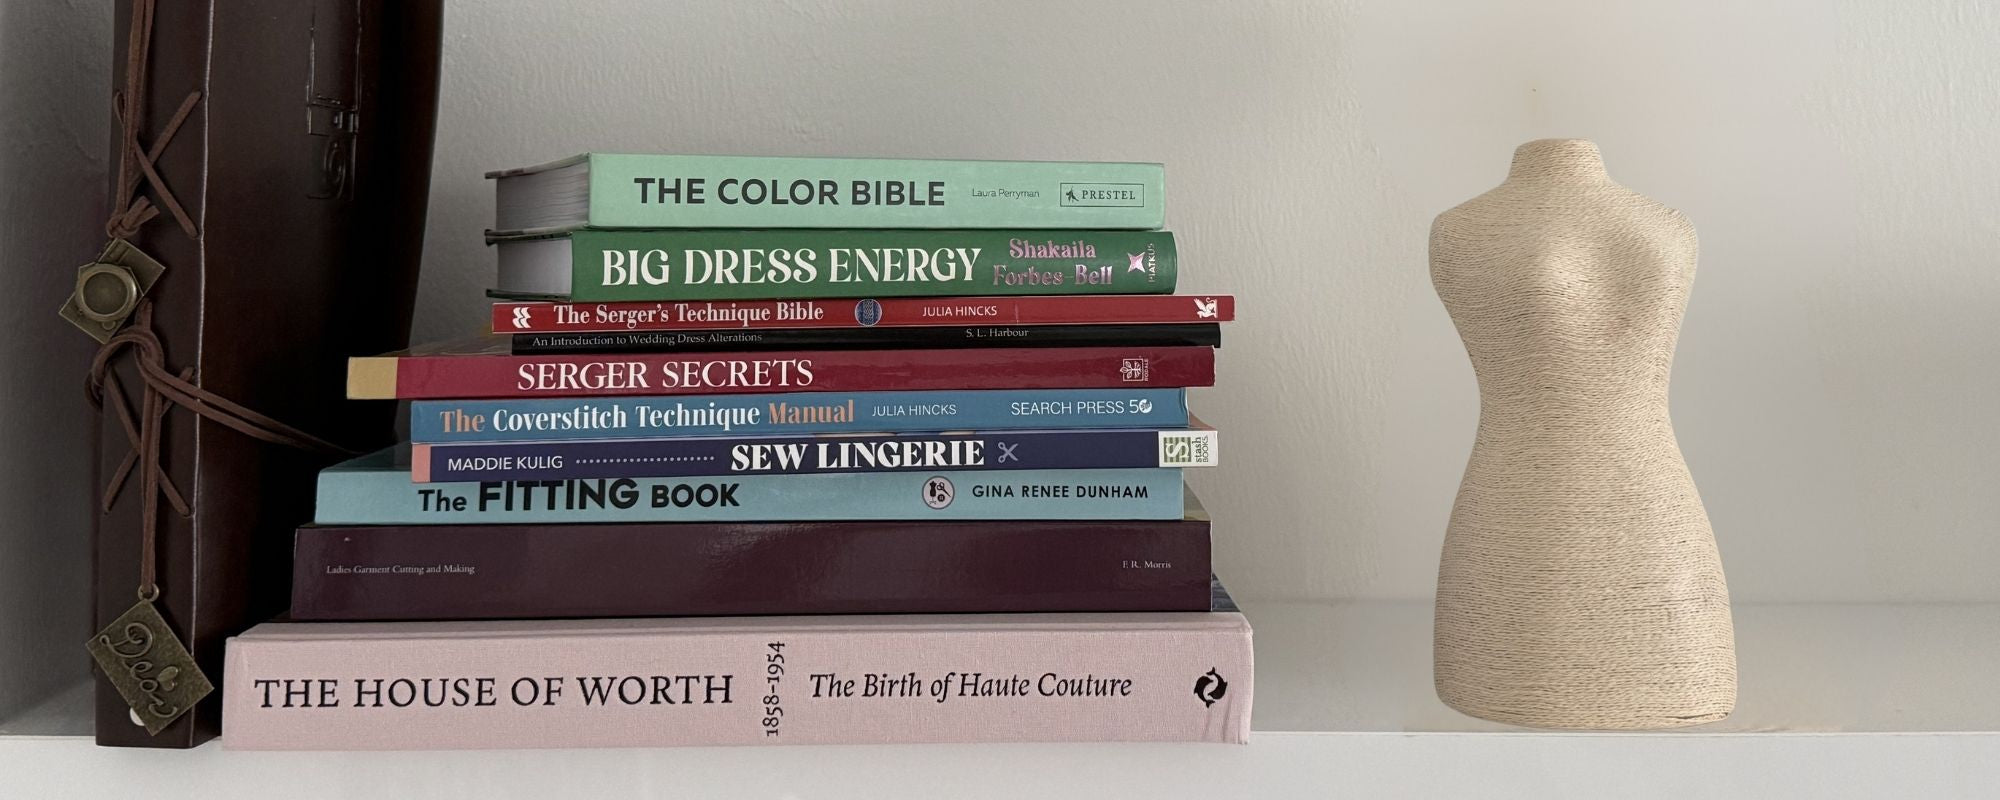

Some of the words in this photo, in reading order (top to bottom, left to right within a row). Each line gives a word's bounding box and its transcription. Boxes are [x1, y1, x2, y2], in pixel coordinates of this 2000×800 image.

[634, 177, 705, 204] THE
[717, 177, 839, 206] COLOR
[852, 180, 945, 206] BIBLE
[972, 188, 996, 198] Laura
[998, 188, 1040, 199] Perryman
[1082, 190, 1136, 200] PRESTEL
[1009, 238, 1097, 259] Shakaila
[602, 249, 670, 286] BIG
[684, 248, 817, 285] DRESS
[829, 247, 981, 283] ENERGY
[554, 305, 590, 324] The
[595, 303, 669, 329] Serger's
[675, 303, 771, 330] Technique
[776, 301, 824, 321] Bible
[922, 305, 953, 317] JULIA
[955, 305, 997, 316] HINCKS
[532, 337, 548, 347] An
[551, 335, 613, 346] Introduction
[616, 337, 626, 345] to
[629, 334, 675, 346] Wedding
[678, 335, 705, 344] Dress
[708, 332, 762, 343] Alterations
[966, 328, 974, 338] S.
[976, 328, 986, 338] L.
[989, 327, 1029, 338] Harbour
[517, 362, 650, 390] SERGER
[662, 359, 813, 387] SECRETS
[440, 410, 485, 433] The
[493, 405, 626, 432] Coverstitch
[635, 402, 760, 430] Technique
[769, 400, 854, 423] Manual
[872, 404, 907, 417] JULIA
[909, 403, 957, 416] HINCKS
[1011, 401, 1072, 416] SEARCH
[1077, 400, 1124, 414] PRESS
[731, 443, 808, 471] SEW
[817, 440, 984, 469] LINGERIE
[1192, 437, 1201, 462] stash
[448, 458, 513, 471] MADDIE
[516, 456, 563, 470] KULIG
[418, 490, 467, 512] The
[479, 478, 640, 512] FITTING
[651, 483, 740, 508] BOOK
[973, 485, 1014, 497] GINA
[1021, 485, 1069, 497] RENEE
[1076, 484, 1148, 498] DUNHAM
[327, 566, 351, 574] Ladies
[353, 566, 390, 574] Garment
[392, 566, 424, 575] Cutting
[426, 565, 441, 573] and
[443, 564, 475, 575] Making
[1122, 560, 1130, 568] F.
[1131, 560, 1141, 568] R.
[1144, 560, 1171, 568] Morris
[255, 679, 339, 708] THE
[353, 678, 497, 707] HOUSE
[511, 677, 565, 706] OF
[577, 675, 734, 706] WORTH
[762, 641, 785, 737] 1858-1954
[810, 674, 855, 698] The
[862, 673, 921, 697] Birth
[931, 672, 954, 703] of
[959, 674, 1029, 697] Haute
[1037, 673, 1132, 697] Couture
